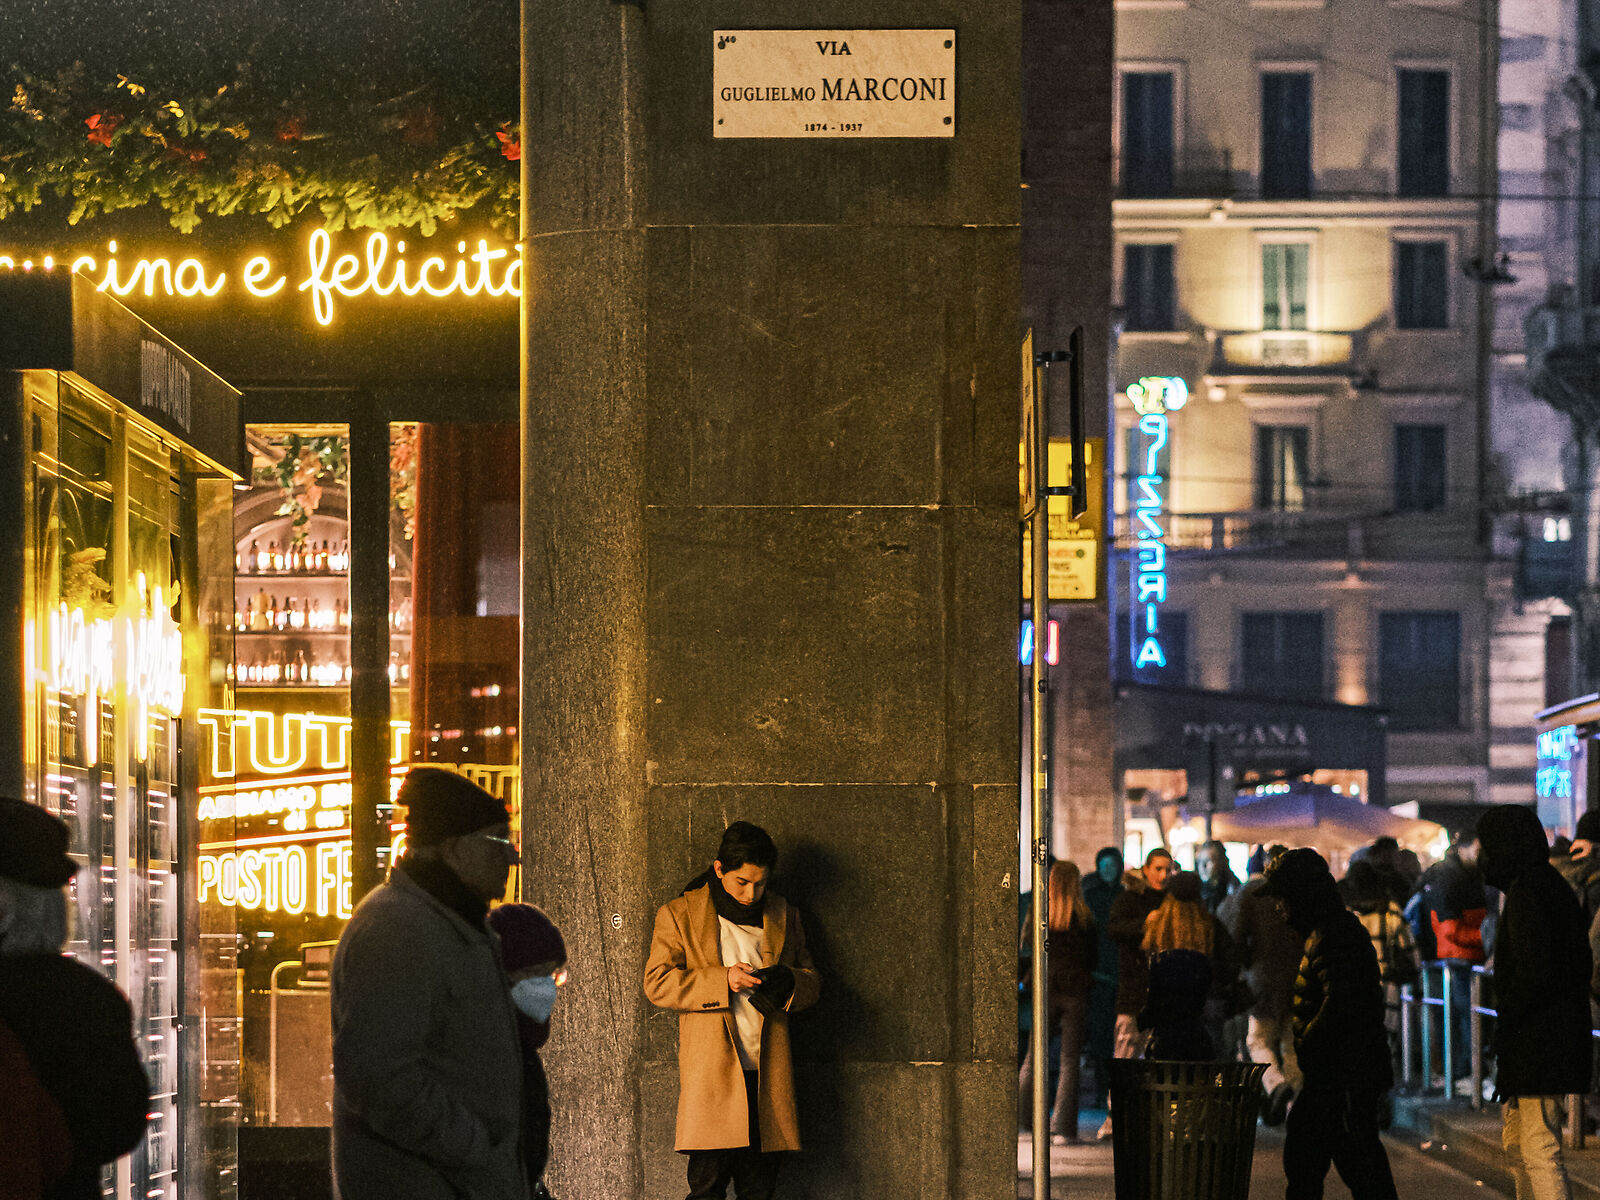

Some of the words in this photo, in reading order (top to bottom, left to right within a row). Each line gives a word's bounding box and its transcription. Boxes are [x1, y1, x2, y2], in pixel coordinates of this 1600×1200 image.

[816, 41, 852, 56] VIA
[720, 87, 816, 102] GUGLIELMO
[821, 77, 947, 101] MARCONI
[804, 123, 828, 132] 1874
[840, 123, 863, 132] 1937
[243, 255, 287, 297] e
[197, 844, 308, 916] POSTO
